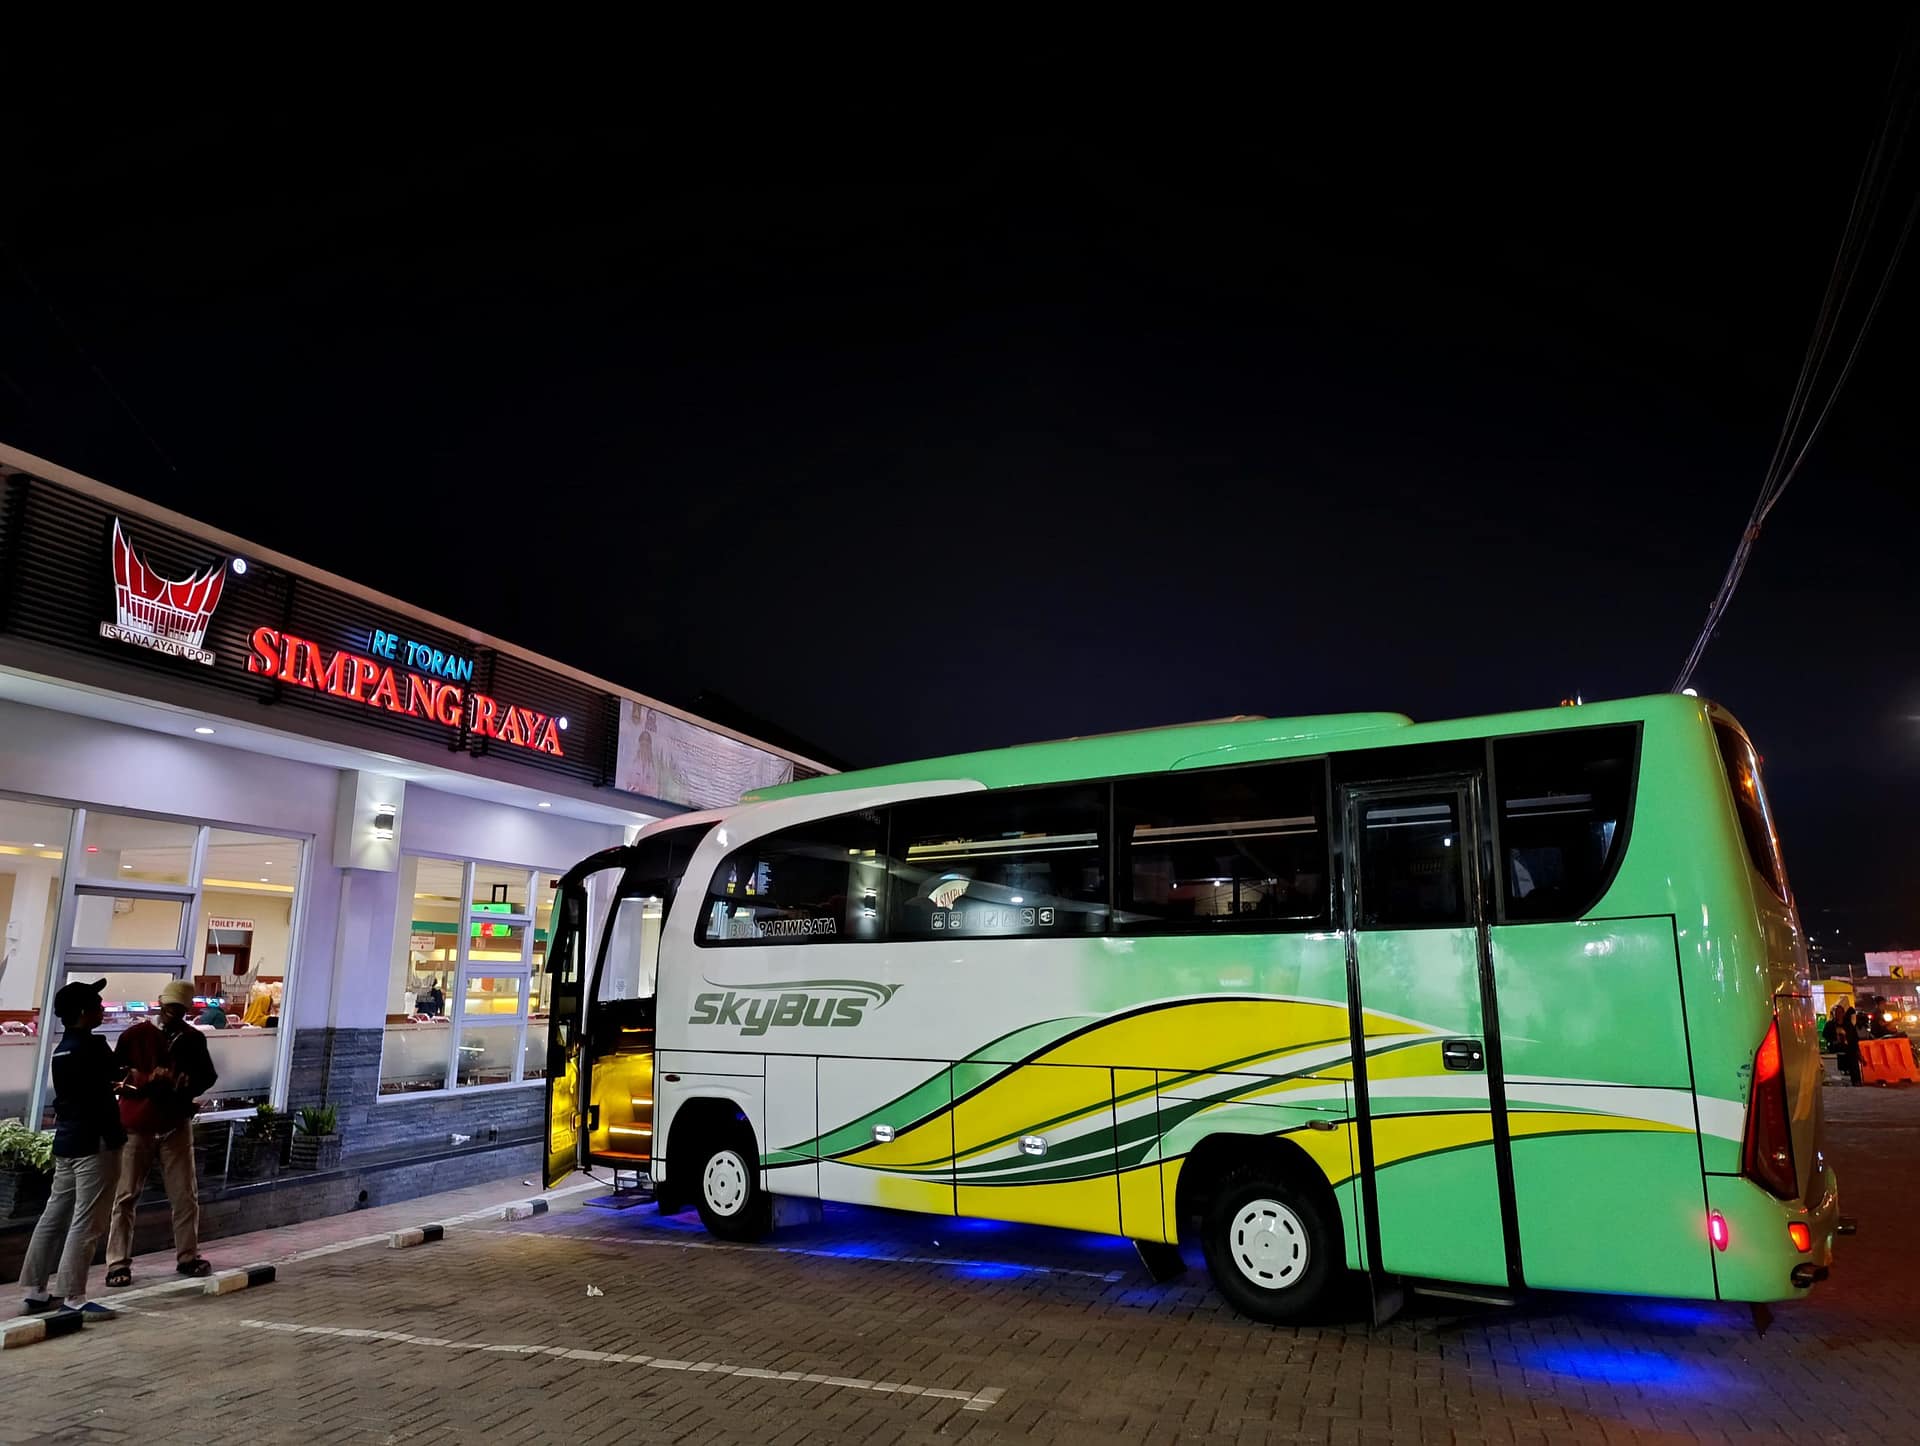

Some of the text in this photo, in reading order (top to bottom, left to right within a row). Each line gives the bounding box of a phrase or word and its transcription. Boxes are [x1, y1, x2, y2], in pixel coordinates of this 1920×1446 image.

[104, 624, 212, 662] ISTANA AYAM POP
[372, 629, 473, 682] RETORAN
[248, 627, 564, 756] SIMPANG RAYA
[211, 920, 252, 928] TOILET PRIA
[759, 917, 837, 937] PARIWISATA
